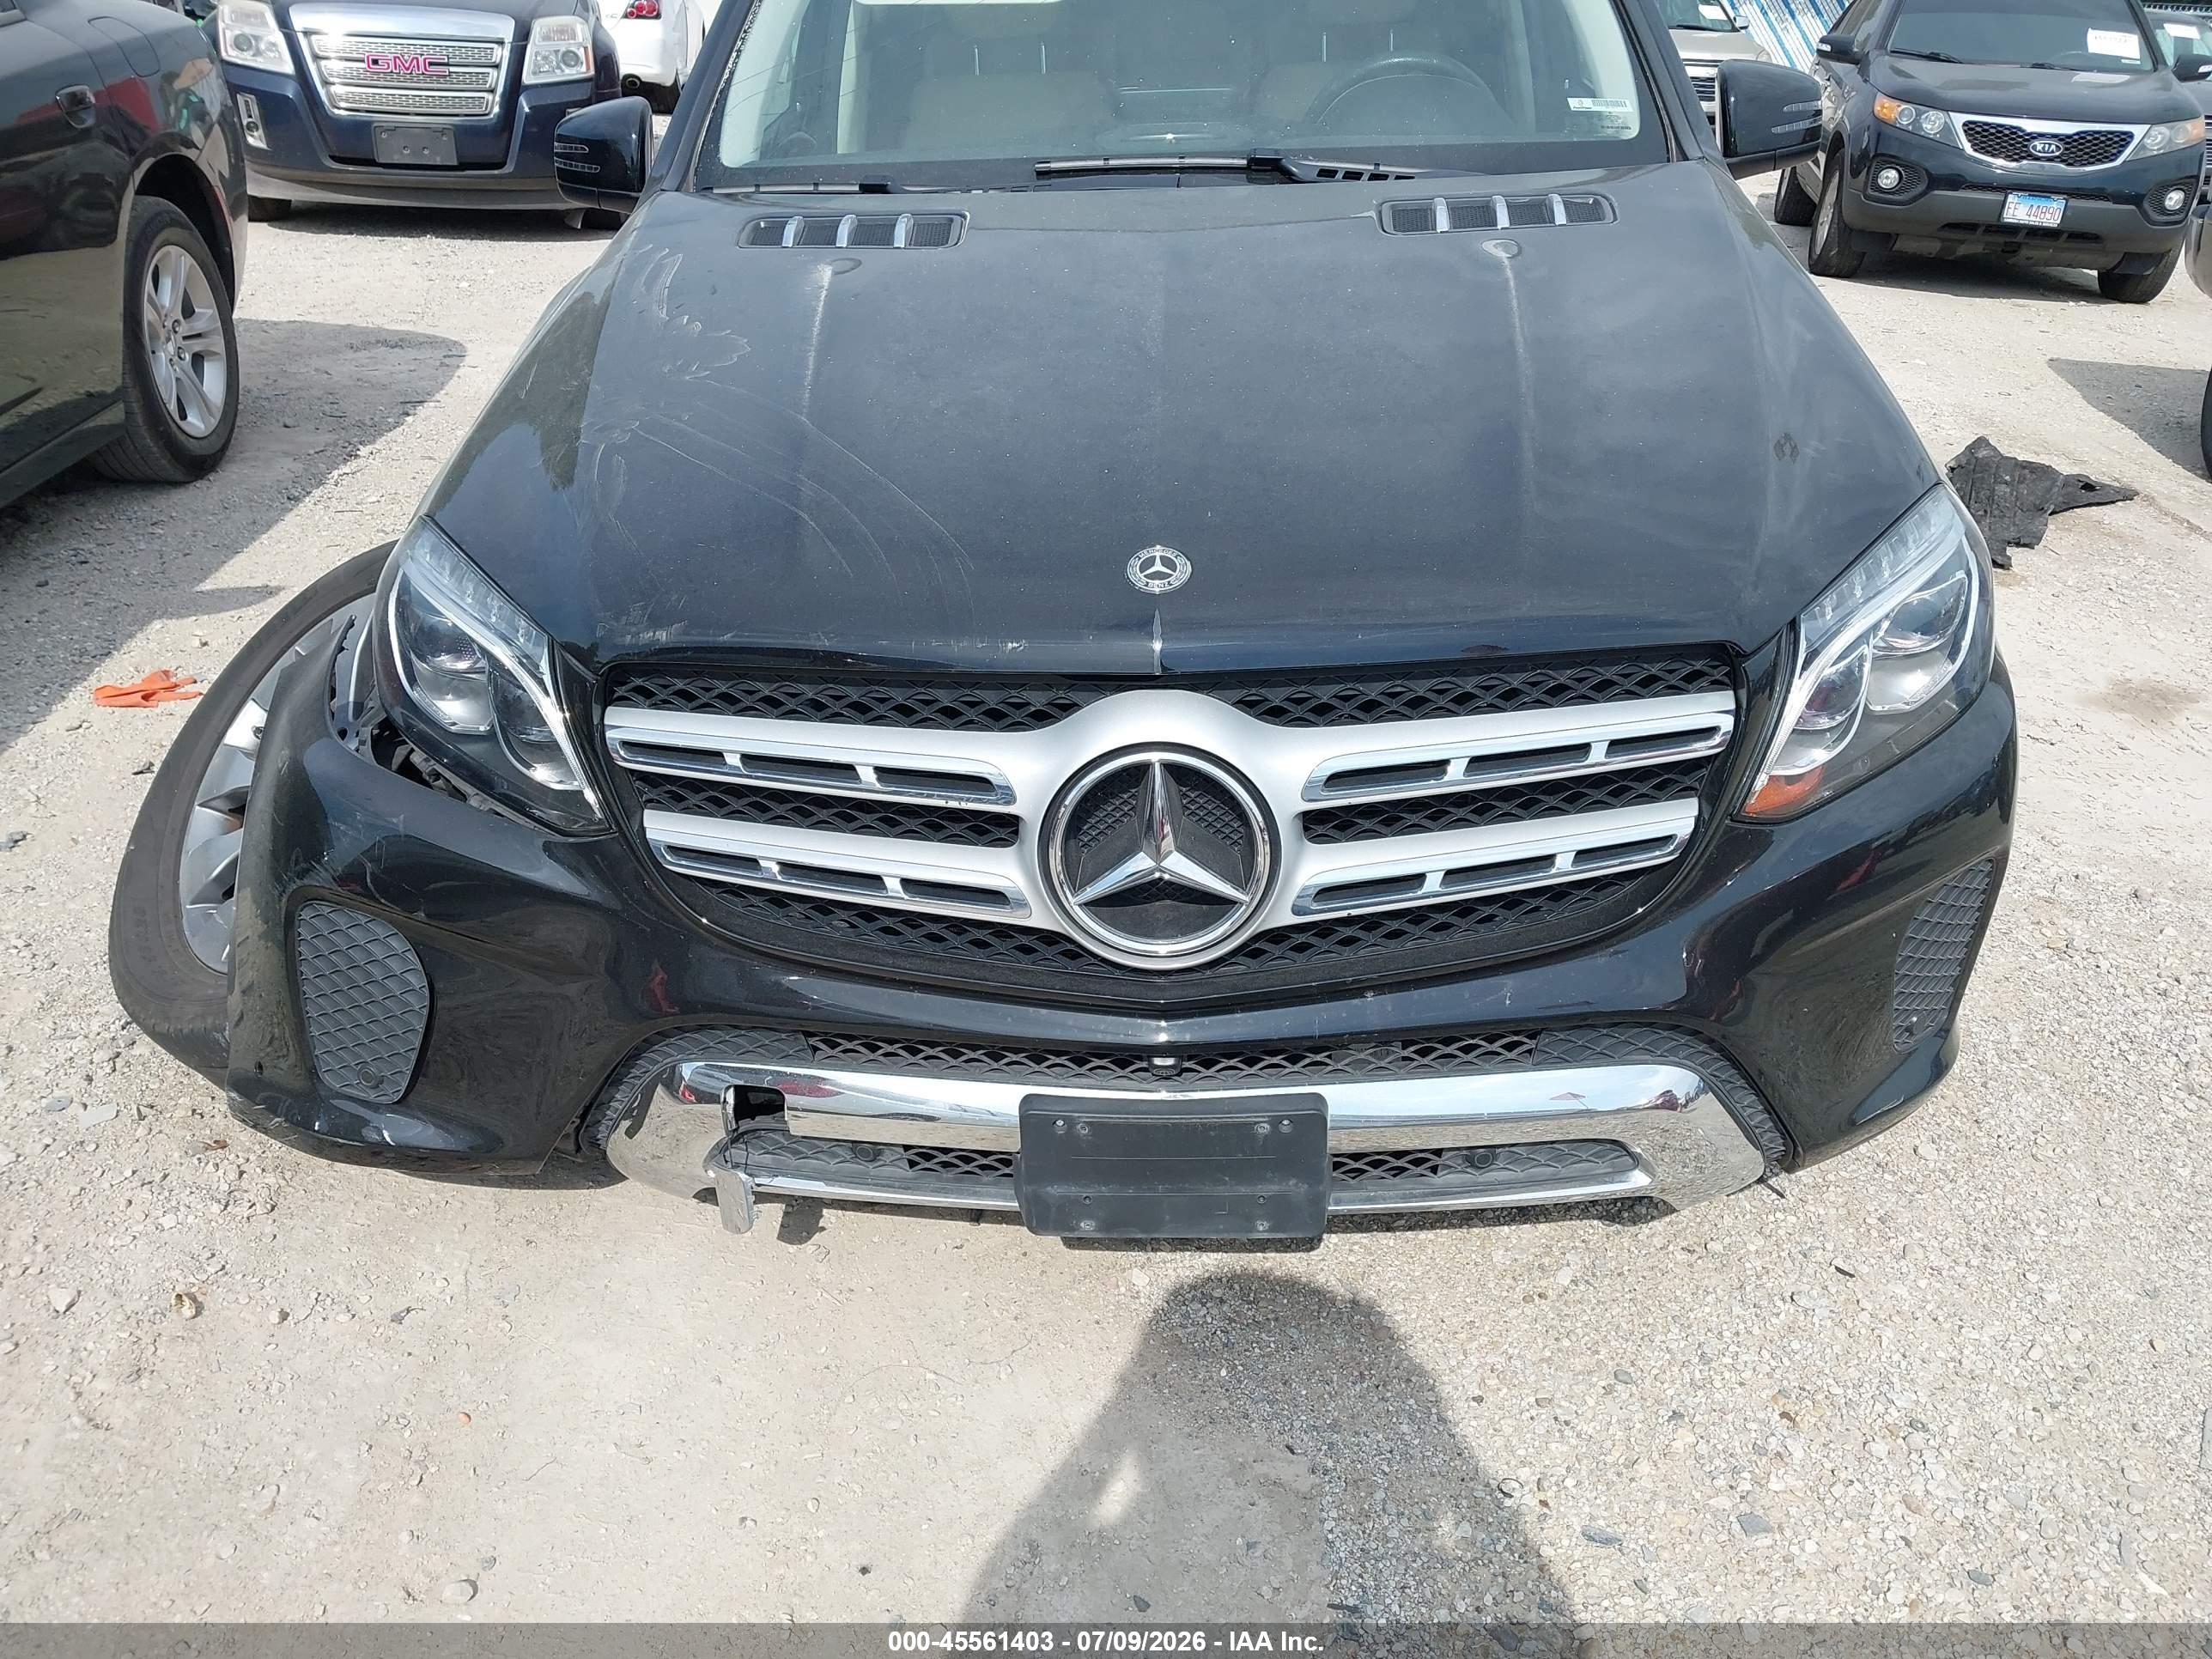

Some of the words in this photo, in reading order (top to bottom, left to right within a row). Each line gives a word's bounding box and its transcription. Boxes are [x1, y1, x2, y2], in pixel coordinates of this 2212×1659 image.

[365, 53, 449, 75] GMC
[2036, 143, 2057, 153] KIA
[2027, 204, 2062, 222] 44890
